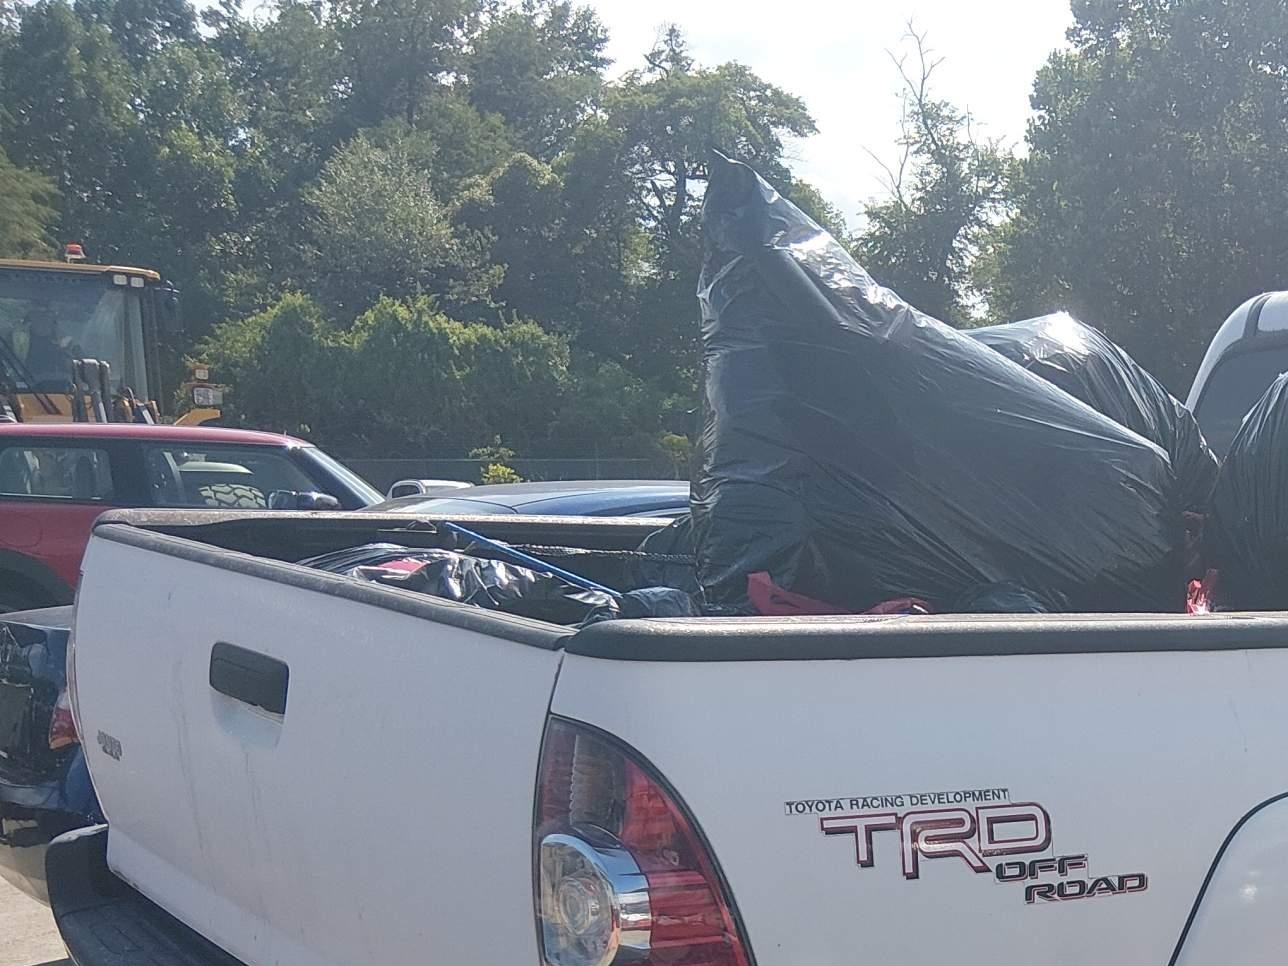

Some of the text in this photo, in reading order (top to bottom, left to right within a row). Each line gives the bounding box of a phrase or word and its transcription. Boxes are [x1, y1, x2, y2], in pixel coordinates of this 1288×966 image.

[786, 789, 1008, 814] TOYOTA RACING DEVELOPMENT
[820, 802, 1052, 879] TRD
[995, 855, 1088, 882] OFF
[1025, 873, 1148, 905] ROAD
